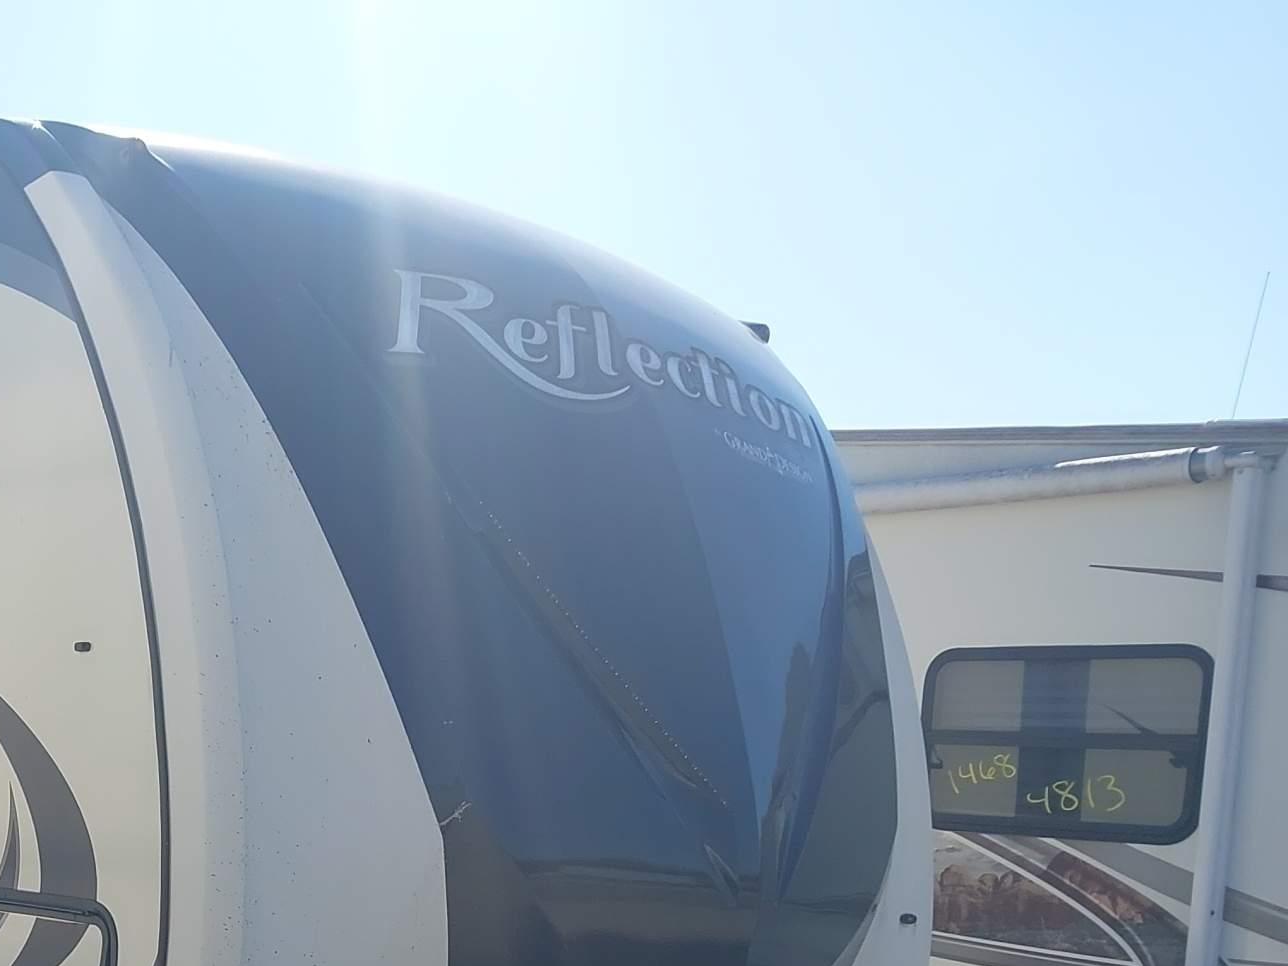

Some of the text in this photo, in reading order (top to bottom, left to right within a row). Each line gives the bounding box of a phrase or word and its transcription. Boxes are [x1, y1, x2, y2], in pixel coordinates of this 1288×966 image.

[386, 268, 812, 448] Reflection
[947, 754, 1017, 794] 1468
[1025, 774, 1127, 814] 4813
